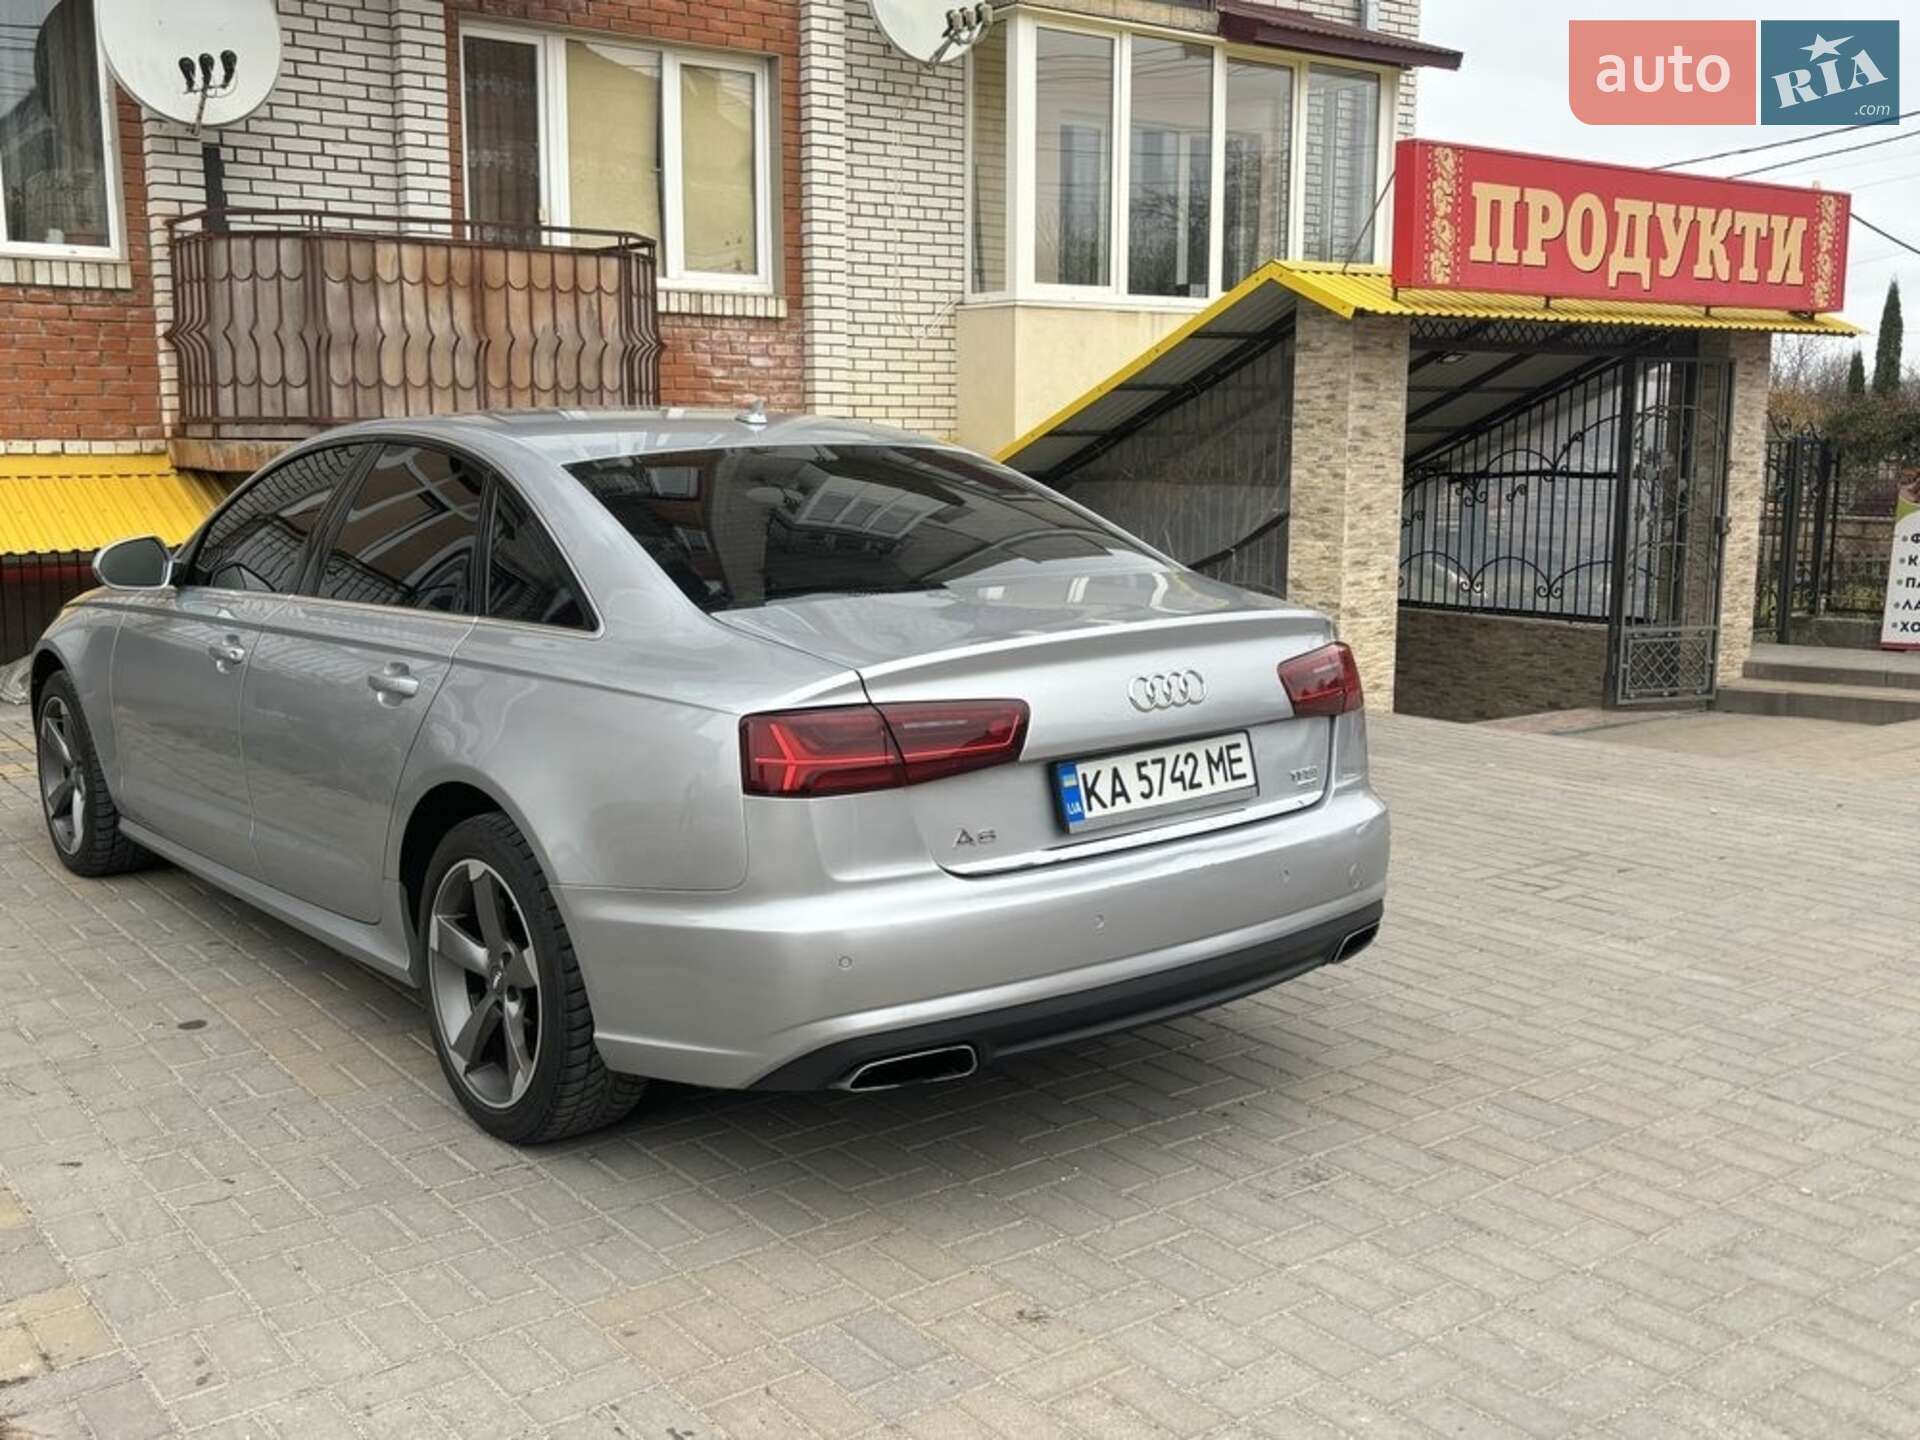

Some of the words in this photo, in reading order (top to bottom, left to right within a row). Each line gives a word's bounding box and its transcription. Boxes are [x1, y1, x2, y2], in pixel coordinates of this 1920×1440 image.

[1470, 181, 1808, 290] ПРОДУКТИ
[1081, 767, 1131, 812] KA
[1136, 752, 1203, 799] 5742
[1205, 742, 1248, 786] ME
